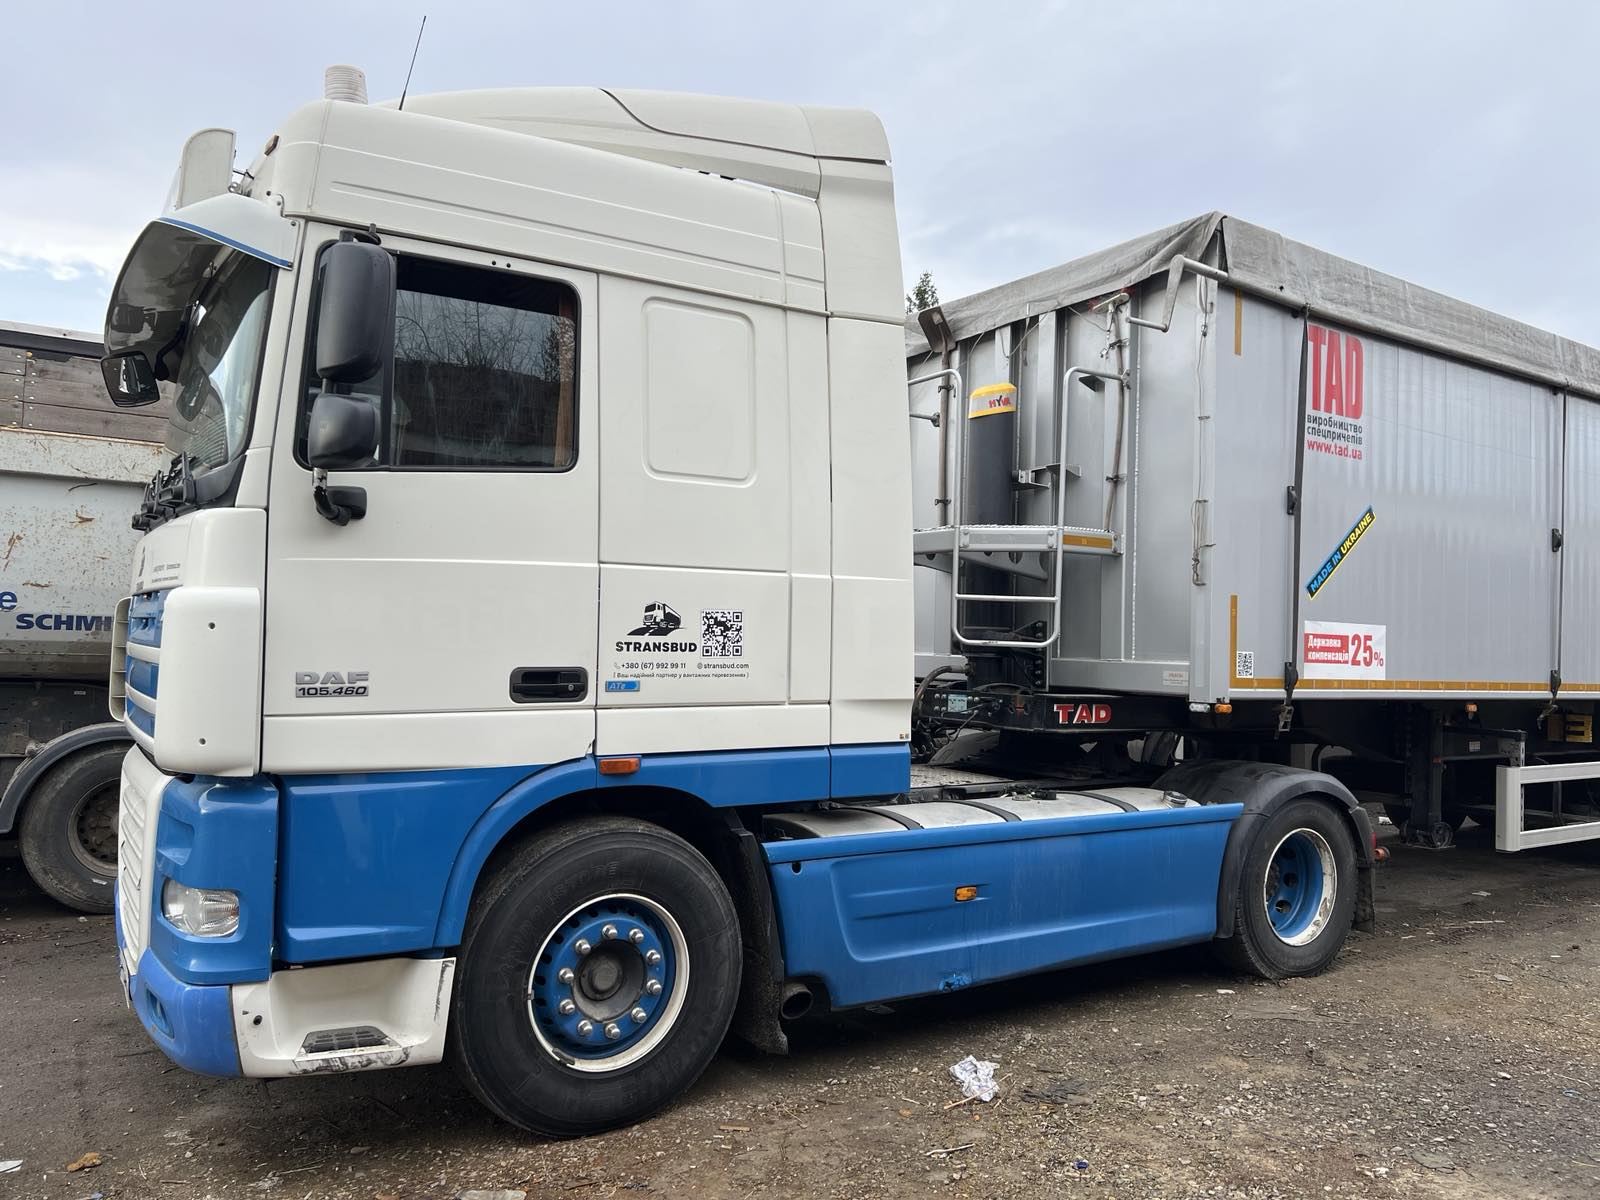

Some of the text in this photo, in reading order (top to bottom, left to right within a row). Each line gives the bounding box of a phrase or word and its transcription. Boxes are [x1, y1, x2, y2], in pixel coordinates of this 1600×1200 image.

[1307, 323, 1364, 420] TAD
[1307, 414, 1363, 434] виробництво
[1307, 425, 1363, 446] спецпричепів
[1306, 439, 1363, 460] www.tad.ua
[1310, 513, 1373, 592] MADE IN UKRAINE
[16, 613, 113, 632] SCHMI
[616, 641, 698, 653] STRANSBUD
[1351, 633, 1384, 667] 25%
[641, 662, 654, 670] (67)
[295, 671, 369, 685] DAF
[298, 686, 368, 696] 105.460
[1054, 703, 1112, 724] TAD
